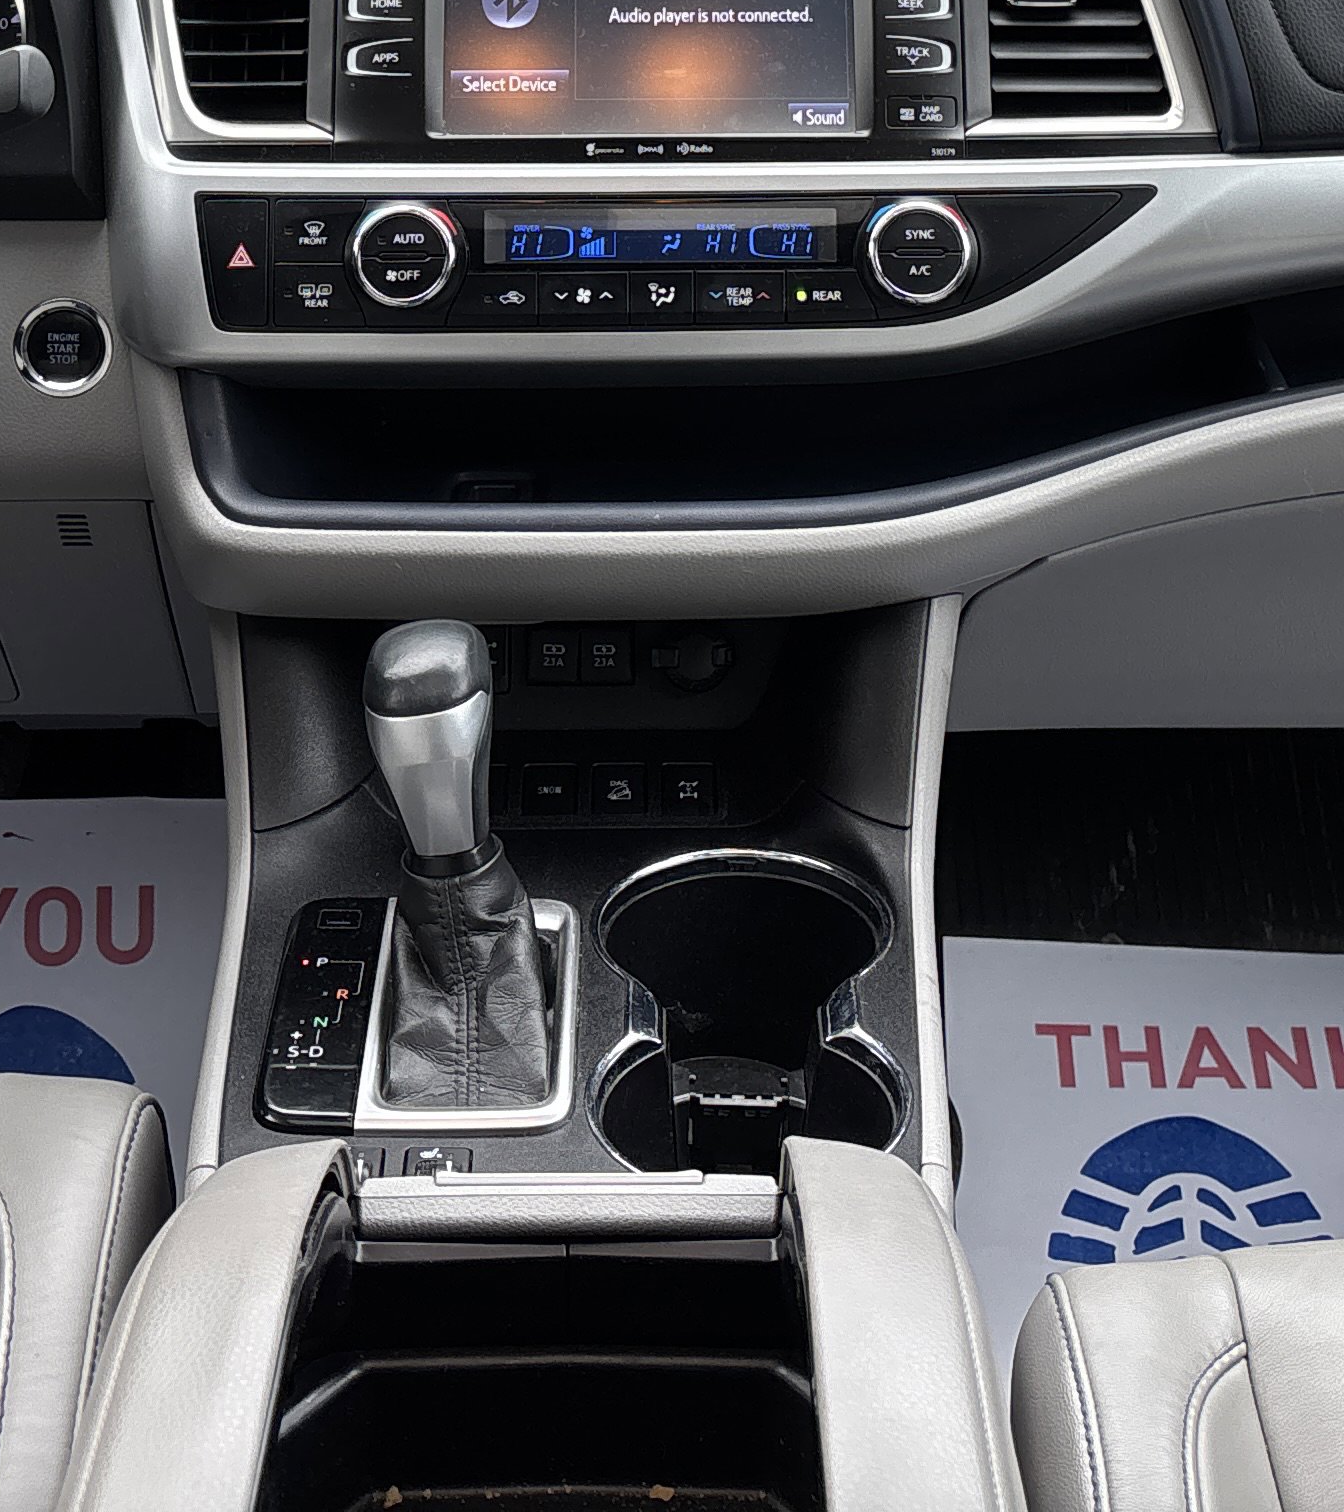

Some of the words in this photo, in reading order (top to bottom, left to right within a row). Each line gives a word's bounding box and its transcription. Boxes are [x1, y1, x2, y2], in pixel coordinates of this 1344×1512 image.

[608, 7, 652, 24] Audio
[654, 7, 695, 26] player
[698, 7, 709, 24] is
[711, 9, 735, 24] not
[738, 5, 813, 24] connected.
[896, 46, 930, 58] TRACK
[372, 52, 400, 64] APPS
[462, 75, 506, 93] Select
[508, 75, 557, 93] Device
[921, 105, 940, 114] MAP
[805, 108, 845, 126] Sound
[919, 114, 944, 123] CARD
[513, 224, 541, 232] DRIVER
[393, 233, 425, 245] AUTO
[905, 228, 936, 240] SYNC
[298, 236, 328, 245] FRONT
[397, 269, 421, 282] OFF
[909, 264, 932, 276] A/C
[726, 287, 753, 297] REAR
[812, 290, 842, 302] REAR
[304, 298, 329, 308] REAR
[726, 297, 754, 307] TEMP
[47, 332, 81, 342] ENGINE
[46, 343, 81, 353] START
[49, 354, 79, 364] STOP
[609, 779, 629, 787] DAC
[316, 957, 329, 968] P
[336, 988, 349, 1000] R
[313, 1016, 329, 1028] N
